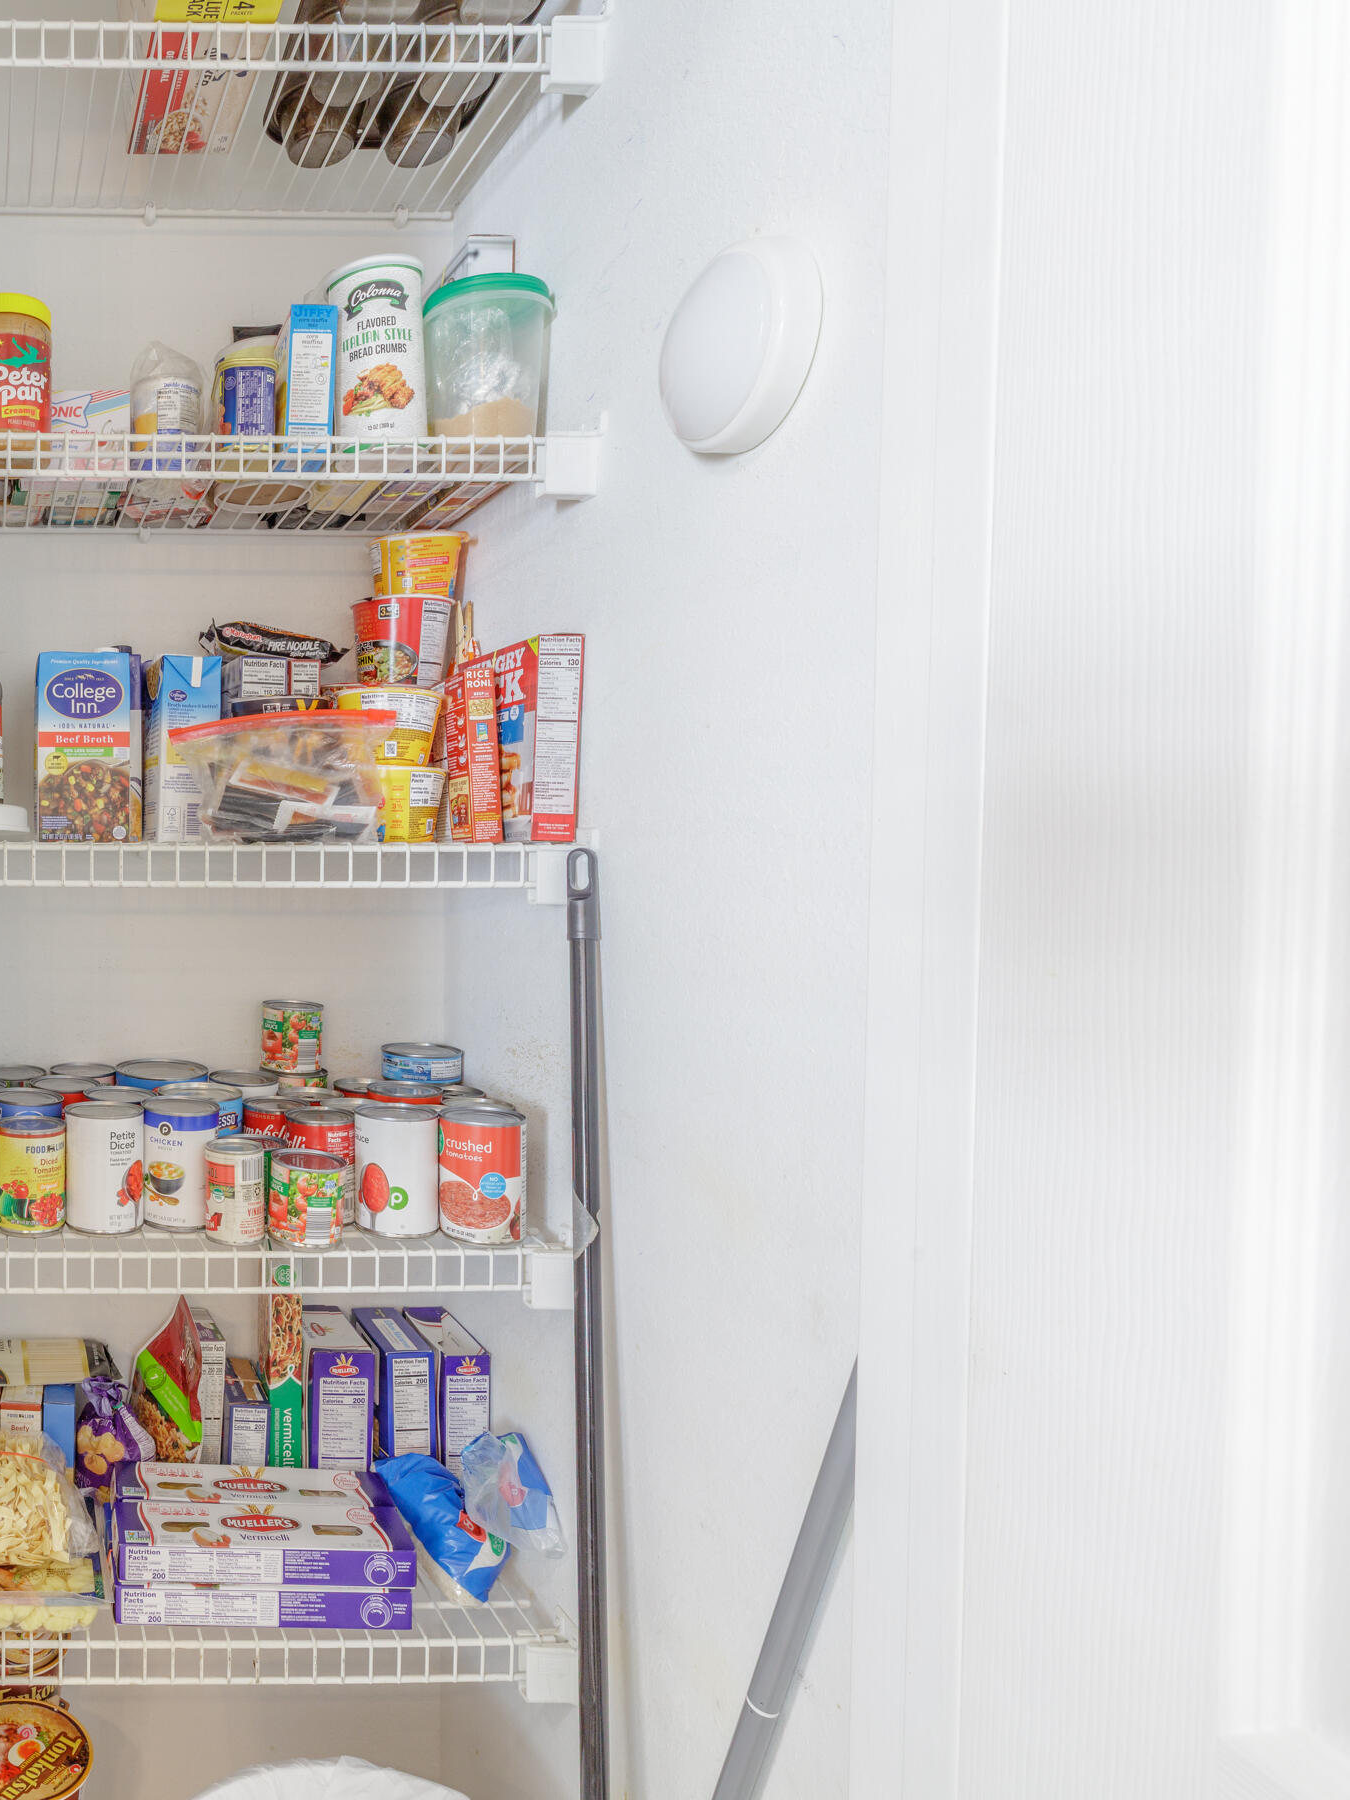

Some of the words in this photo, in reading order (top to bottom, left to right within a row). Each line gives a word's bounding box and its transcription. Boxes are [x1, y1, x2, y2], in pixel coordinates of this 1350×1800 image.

[233, 1, 255, 10] 4
[351, 283, 402, 307] Colonna
[294, 306, 332, 318] JIFFY
[357, 316, 397, 332] FLAVORED
[342, 330, 380, 353] ITALIAN
[385, 327, 413, 342] STYLE
[349, 345, 373, 363] BREAD
[375, 343, 407, 356] CRUMBS
[4, 408, 36, 416] Creamy
[50, 406, 82, 418] ONIC
[230, 628, 262, 642] Maruchan
[267, 641, 289, 651] FIRE
[289, 640, 320, 651] NOODLE
[243, 659, 268, 668] Nutrition
[466, 669, 490, 679] RICE
[52, 683, 116, 702] College
[56, 735, 80, 744] Beef
[83, 735, 114, 744] Broth
[110, 1131, 136, 1141] Petite
[150, 1136, 183, 1147] CHICKEN
[355, 1134, 369, 1144] auce
[26, 1146, 46, 1154] FOOD
[110, 1140, 135, 1151] Diced
[445, 1137, 492, 1154] crushed
[445, 1149, 483, 1163] tomatoes
[40, 1158, 58, 1167] Diced
[11, 1424, 30, 1433] Beefy
[219, 1480, 282, 1492] MUELLER'S
[230, 1492, 278, 1500] Vermicelli
[226, 1517, 294, 1528] MUELLER'S
[239, 1533, 290, 1542] Vermicelli
[152, 1572, 166, 1580] 200
[1, 1735, 84, 1800] Tonkotsu
